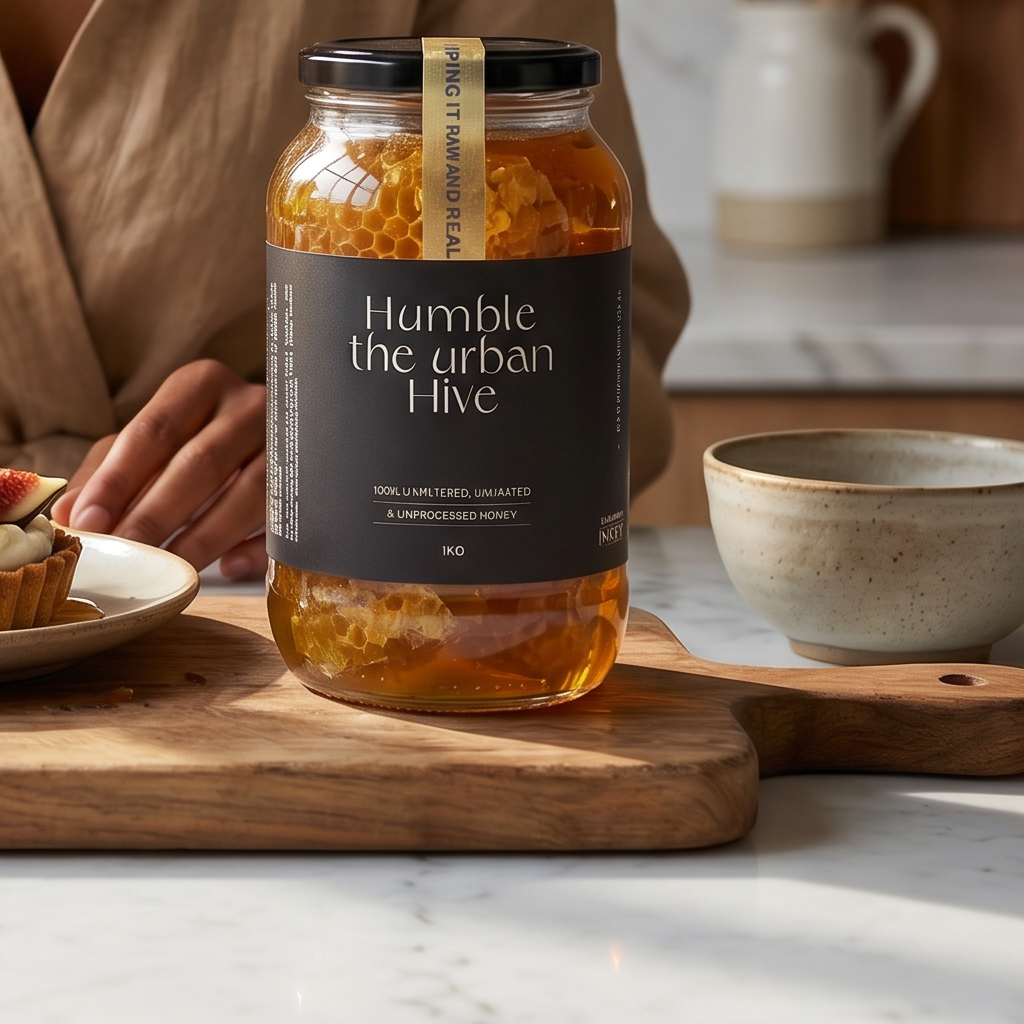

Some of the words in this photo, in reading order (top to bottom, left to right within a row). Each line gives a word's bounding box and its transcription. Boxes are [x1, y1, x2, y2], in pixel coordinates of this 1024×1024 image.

[445, 102, 461, 121] IT
[445, 124, 461, 162] RAW
[445, 163, 461, 204] AND
[445, 207, 461, 260] REAL
[366, 293, 537, 333] Humble
[348, 331, 417, 374] the
[431, 334, 553, 375] urban
[408, 377, 499, 414] Hive
[386, 508, 395, 519] &
[397, 509, 477, 521] UNPROCESSED
[479, 510, 518, 520] HONEY
